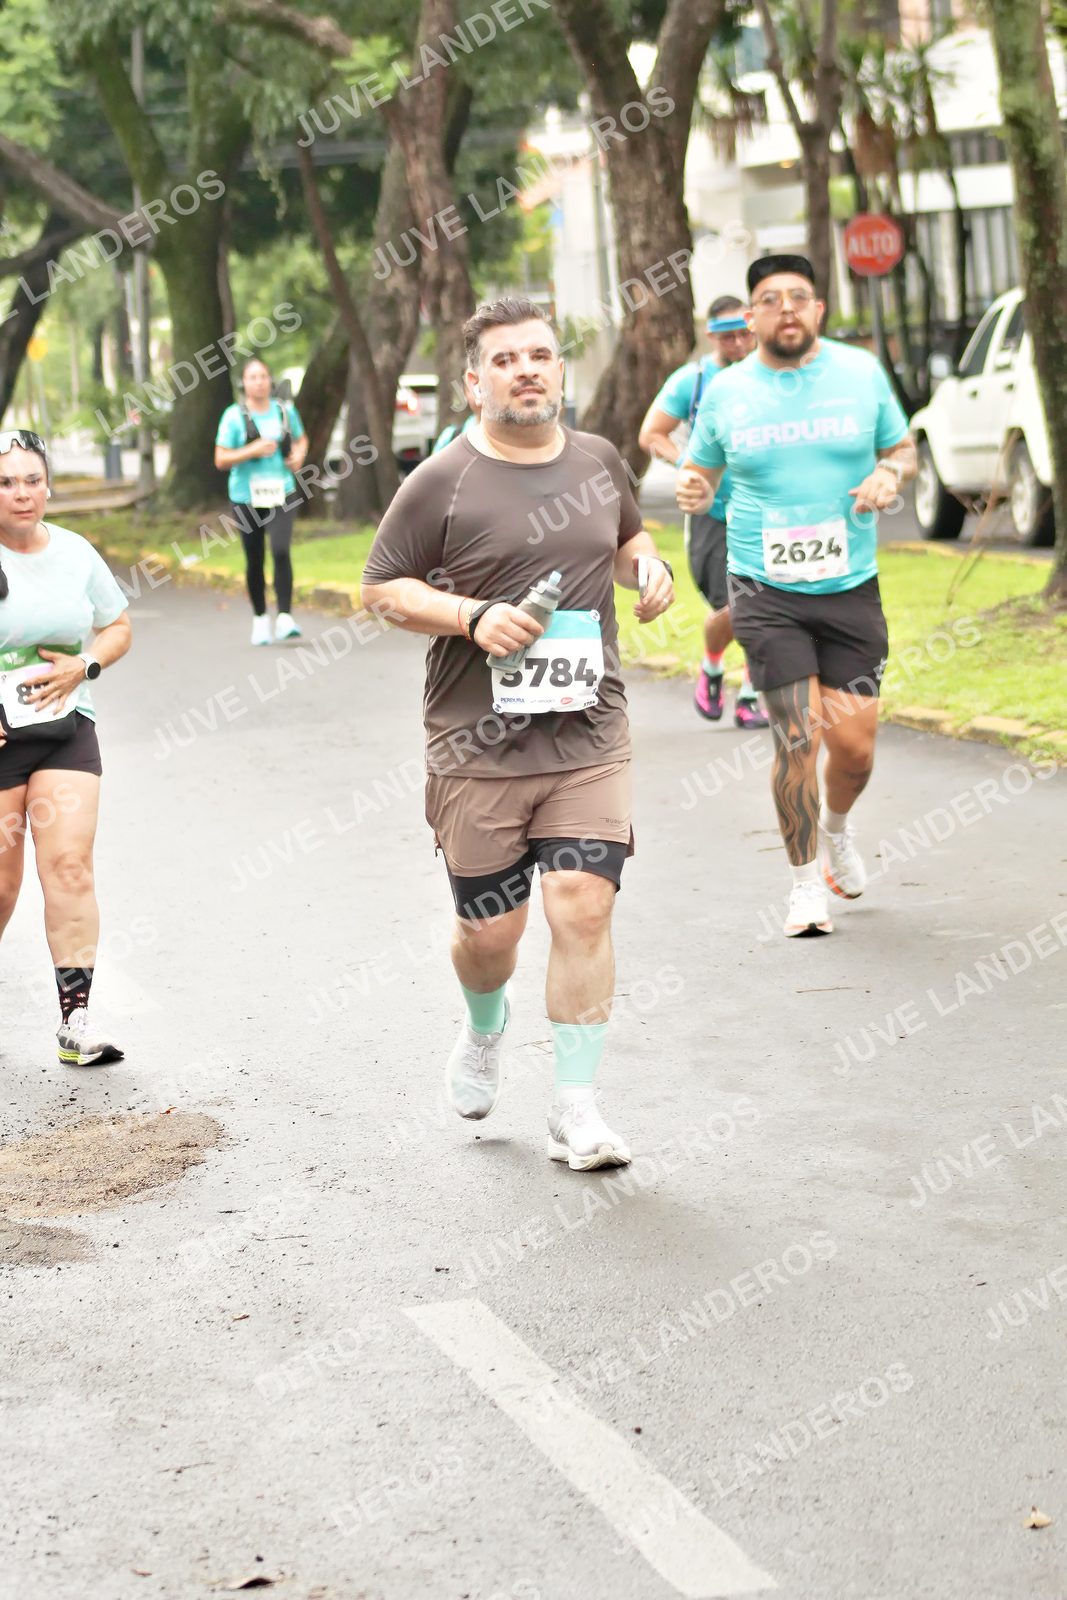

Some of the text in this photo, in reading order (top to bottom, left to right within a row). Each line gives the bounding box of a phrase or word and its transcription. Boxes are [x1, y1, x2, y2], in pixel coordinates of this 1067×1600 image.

[847, 232, 900, 257] ALTO
[730, 416, 860, 450] PERDURA
[770, 537, 842, 565] 2624
